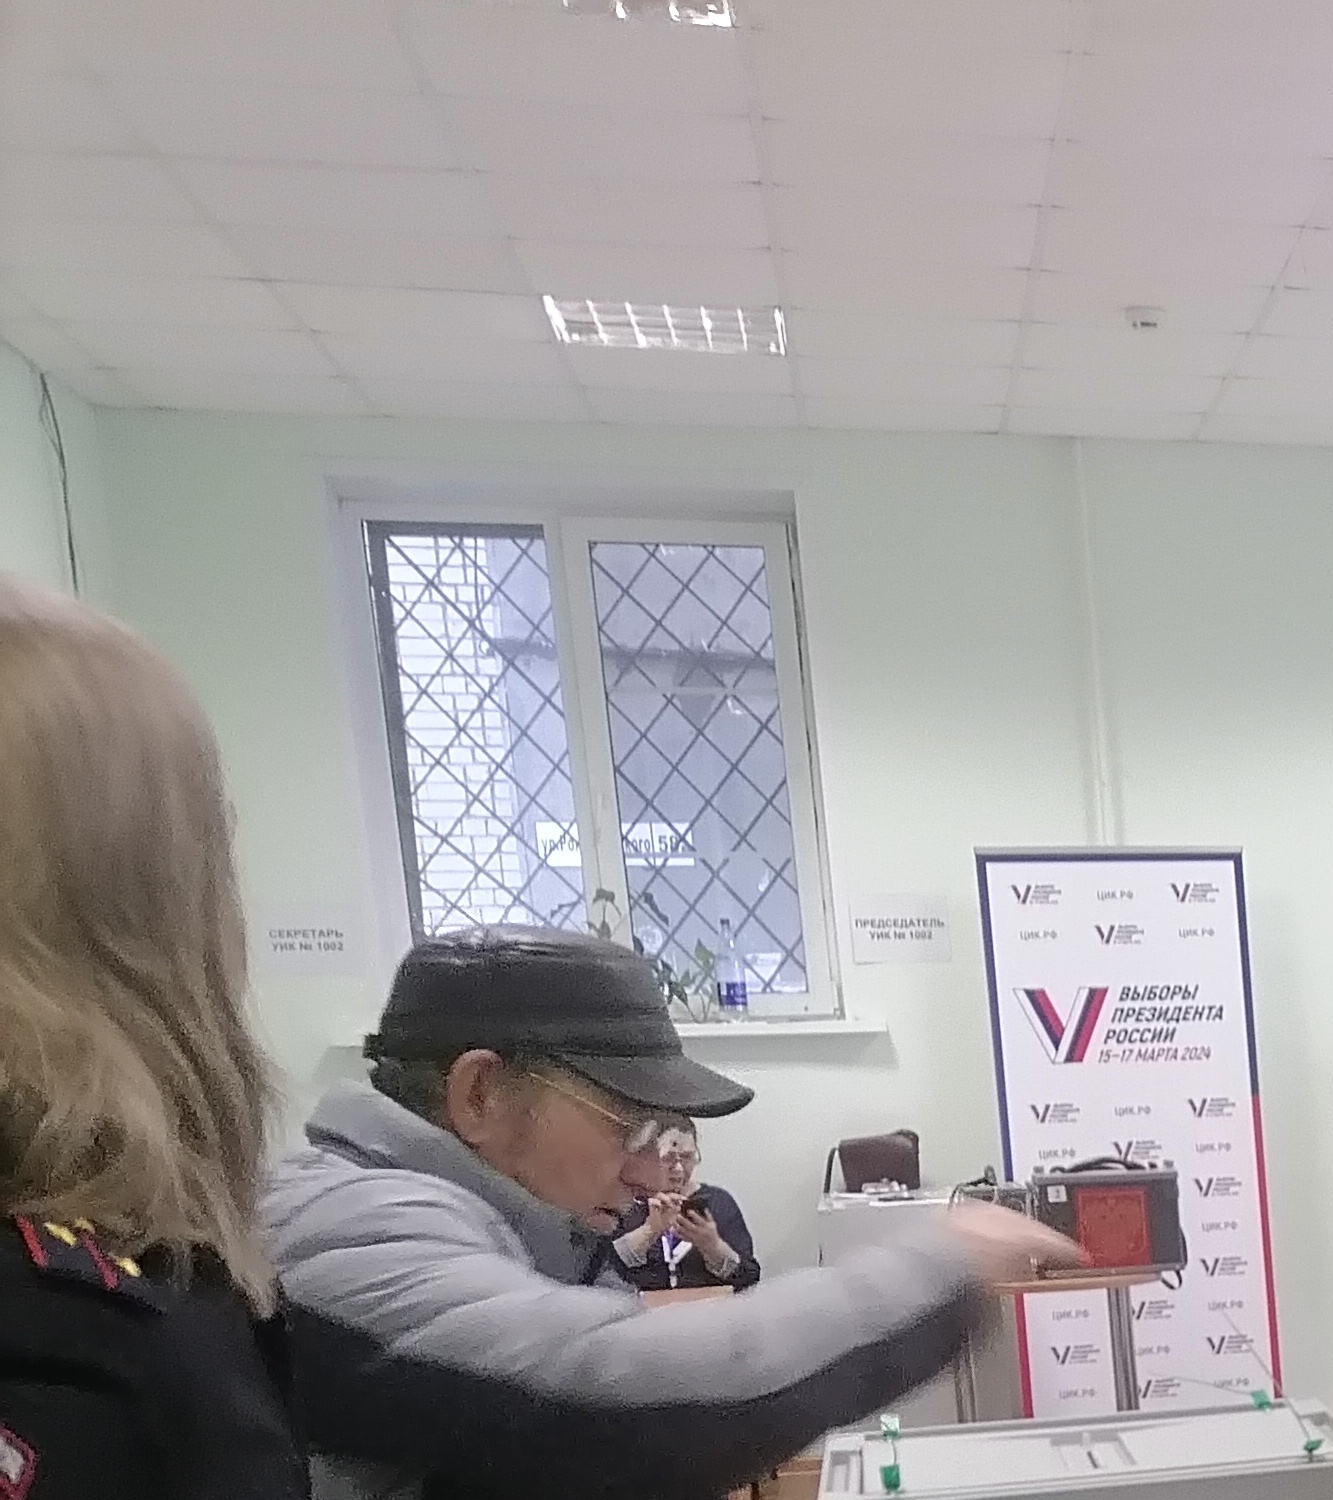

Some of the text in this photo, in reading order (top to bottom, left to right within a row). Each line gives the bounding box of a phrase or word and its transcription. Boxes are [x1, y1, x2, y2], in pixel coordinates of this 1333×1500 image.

[855, 918, 945, 929] ПРЕДСЕДАТЕЛЬ
[268, 929, 344, 940] СЕКРЕТАРЬ
[869, 930, 892, 941] УИК
[272, 941, 296, 952] УИК
[1118, 984, 1199, 1002] ВЫБОРЫ
[1110, 1004, 1224, 1024] ПРЕЗИДЕНТА
[1103, 1026, 1177, 1045] РОССИИ
[1135, 1047, 1179, 1063] МАРТА
[1181, 1045, 1212, 1061] 2024
